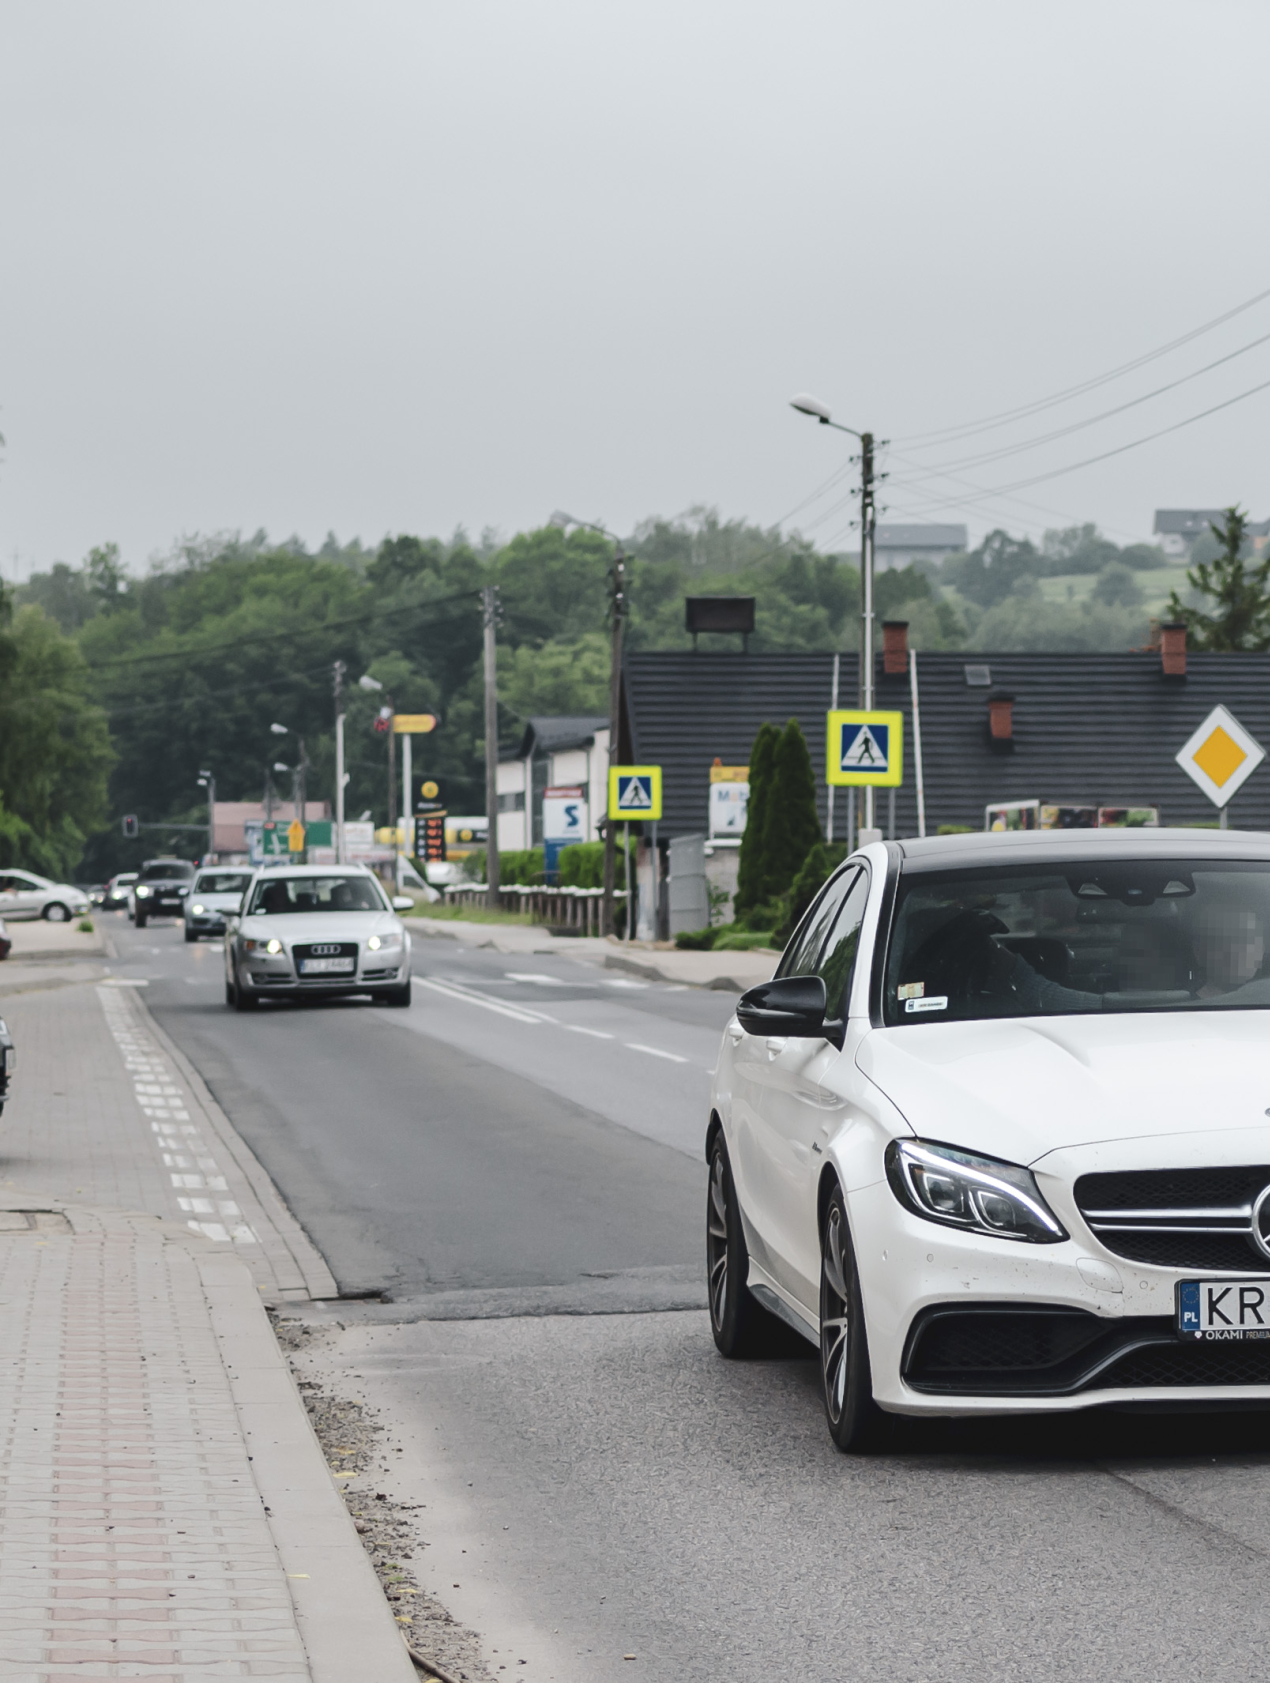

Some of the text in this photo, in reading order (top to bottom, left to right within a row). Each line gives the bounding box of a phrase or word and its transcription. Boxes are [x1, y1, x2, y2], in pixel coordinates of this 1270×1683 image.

[1207, 1286, 1265, 1326] KR
[1184, 1311, 1198, 1322] PL
[1205, 1330, 1243, 1340] OKAMI
